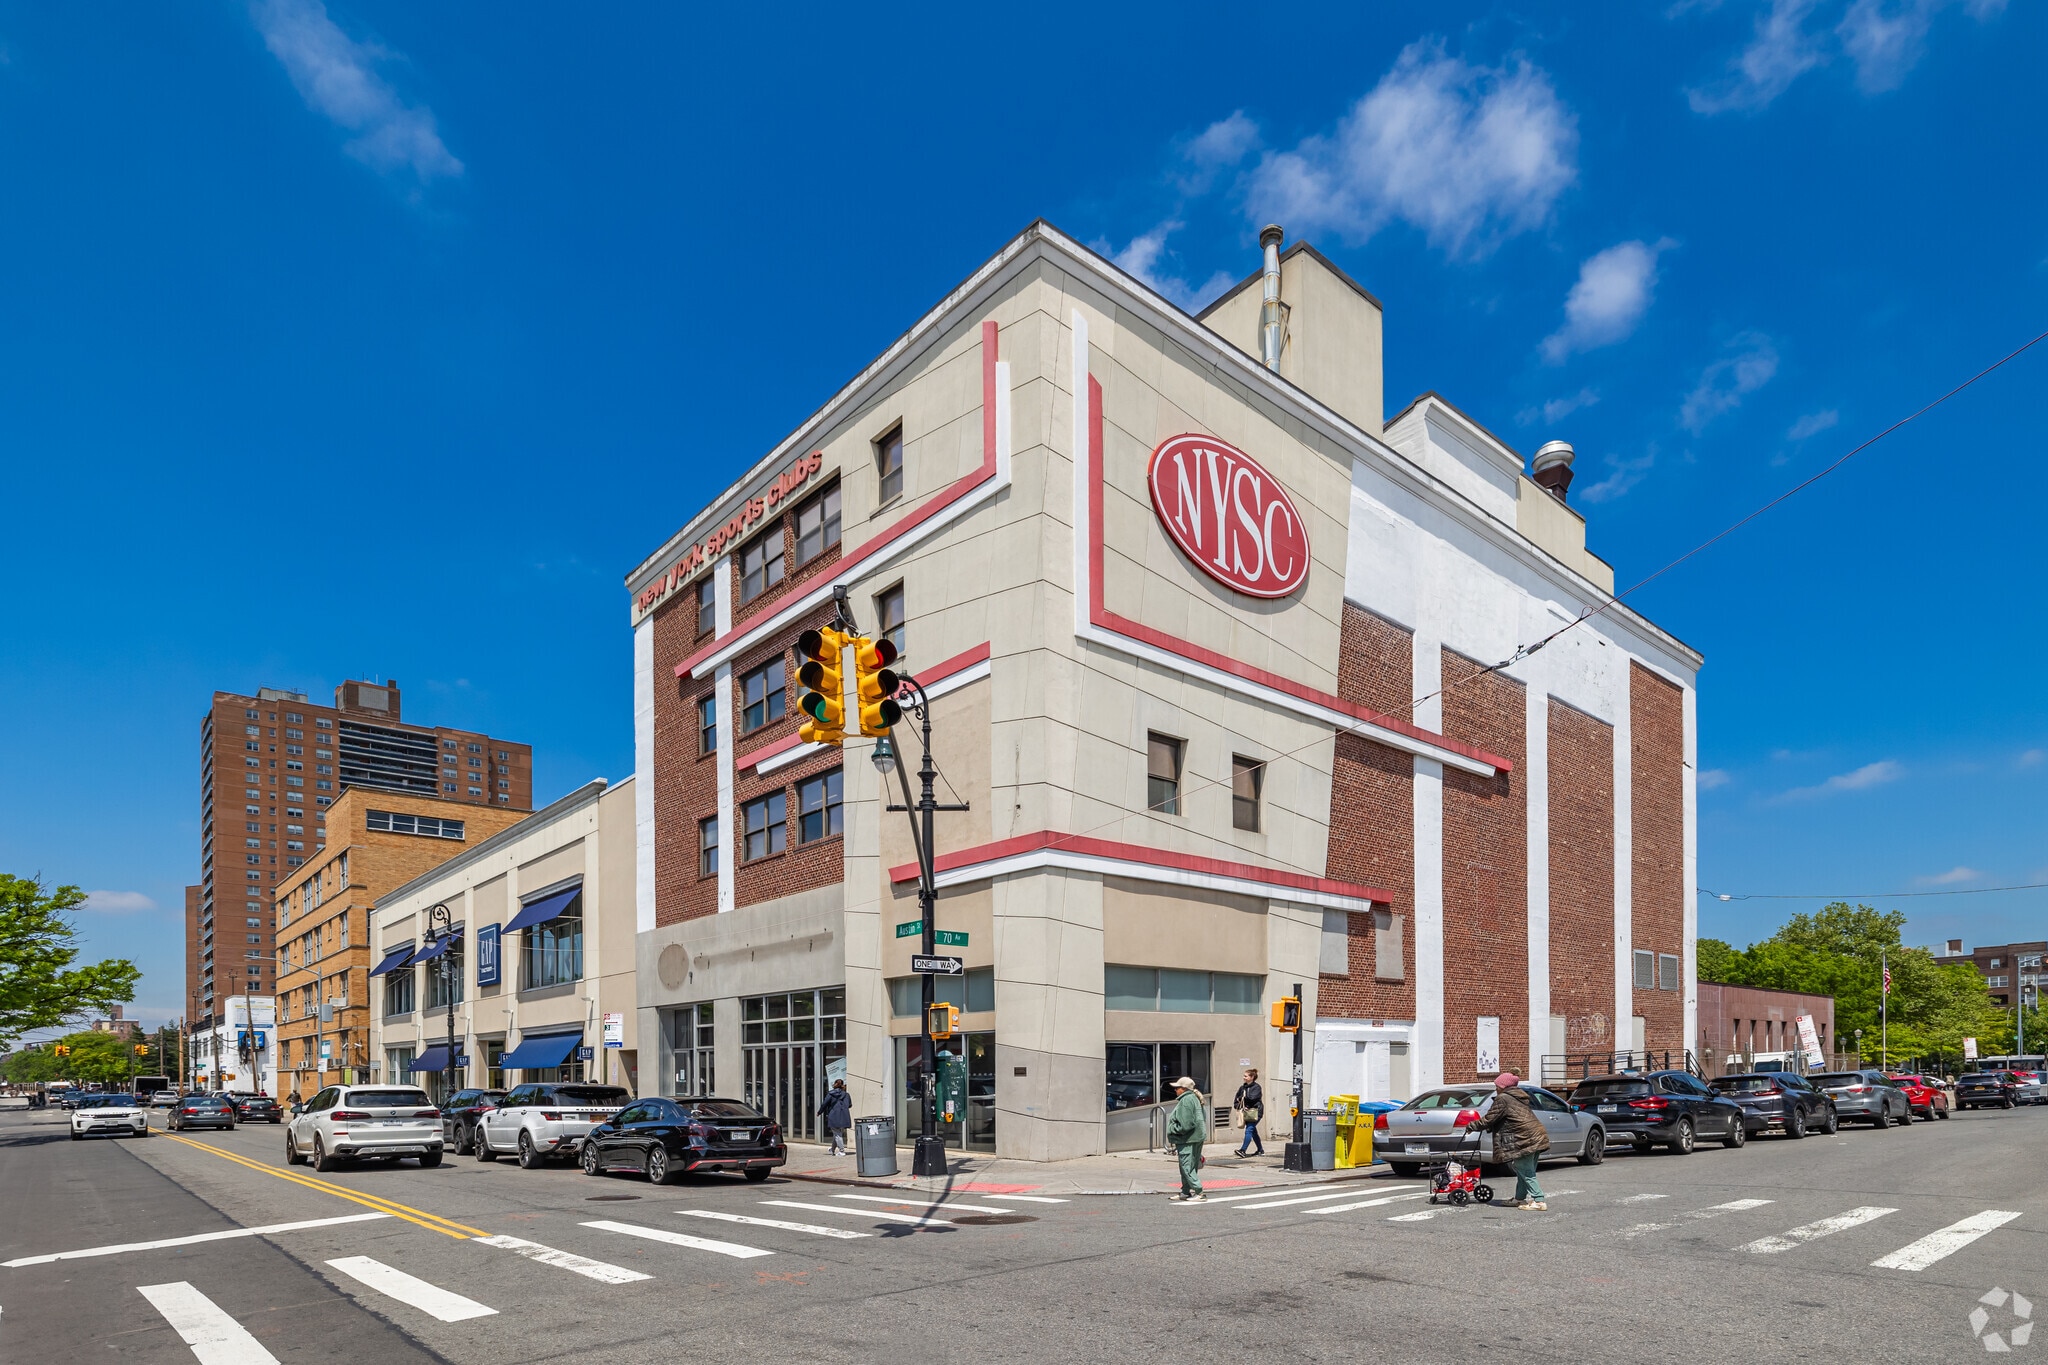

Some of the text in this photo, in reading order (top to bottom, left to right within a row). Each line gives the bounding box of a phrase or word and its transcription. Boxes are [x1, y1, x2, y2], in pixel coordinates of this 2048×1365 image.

[1173, 449, 1293, 582] NYSC
[638, 450, 822, 612] new york sports clubs
[899, 924, 916, 934] Austin
[944, 933, 952, 944] 70
[916, 960, 957, 970] ONE WAY
